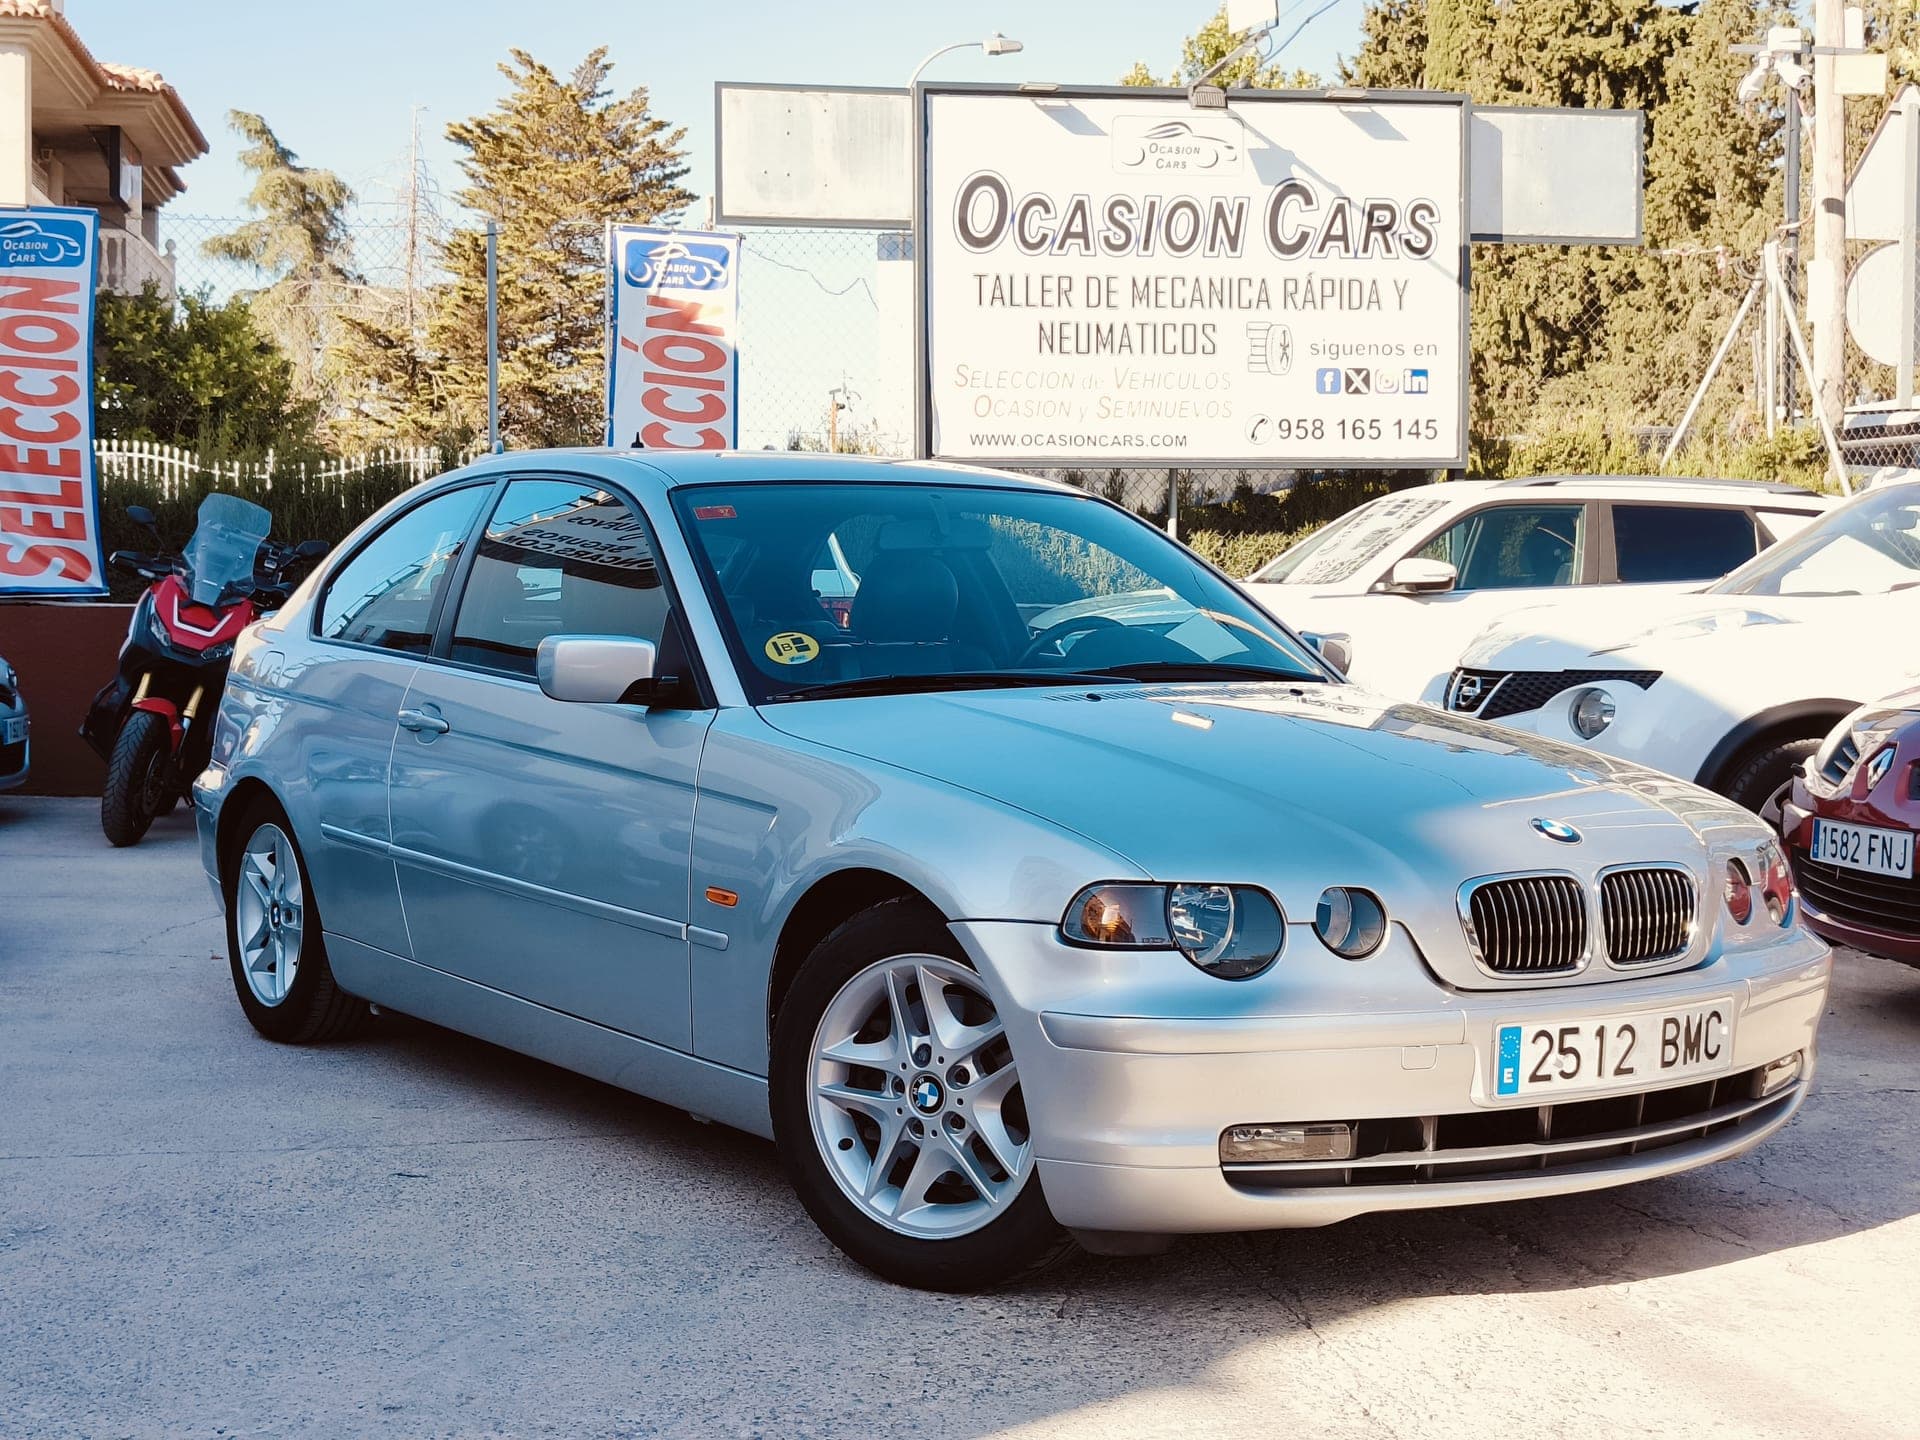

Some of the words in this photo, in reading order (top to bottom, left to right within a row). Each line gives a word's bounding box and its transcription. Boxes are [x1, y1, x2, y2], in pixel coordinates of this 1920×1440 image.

[1149, 143, 1200, 155] OCASION
[1156, 158, 1187, 169] CARS
[953, 170, 1250, 257] OCASION
[1264, 178, 1440, 260] CARS
[3, 240, 48, 250] OCASION
[9, 253, 36, 263] CARS
[973, 274, 1073, 307] TALLER
[1086, 276, 1118, 308] DE
[1131, 276, 1270, 310] MECANICA
[1283, 272, 1381, 311] RÁPIDA
[1393, 278, 1408, 311] Y
[1039, 321, 1216, 356] NEUMATICOS
[1414, 343, 1438, 356] en
[954, 363, 1074, 389] SELECCION
[974, 395, 1073, 418] OCASION
[1278, 418, 1325, 440] 958
[1336, 418, 1382, 440] 165
[1393, 418, 1439, 440] 145
[969, 434, 1188, 447] WWW.OCASIONCARS.COM
[1823, 826, 1861, 864] 1582
[1868, 834, 1907, 871] FNJ
[1528, 1023, 1636, 1083] 2512
[1661, 1010, 1722, 1069] BMC
[1503, 1068, 1514, 1084] E
